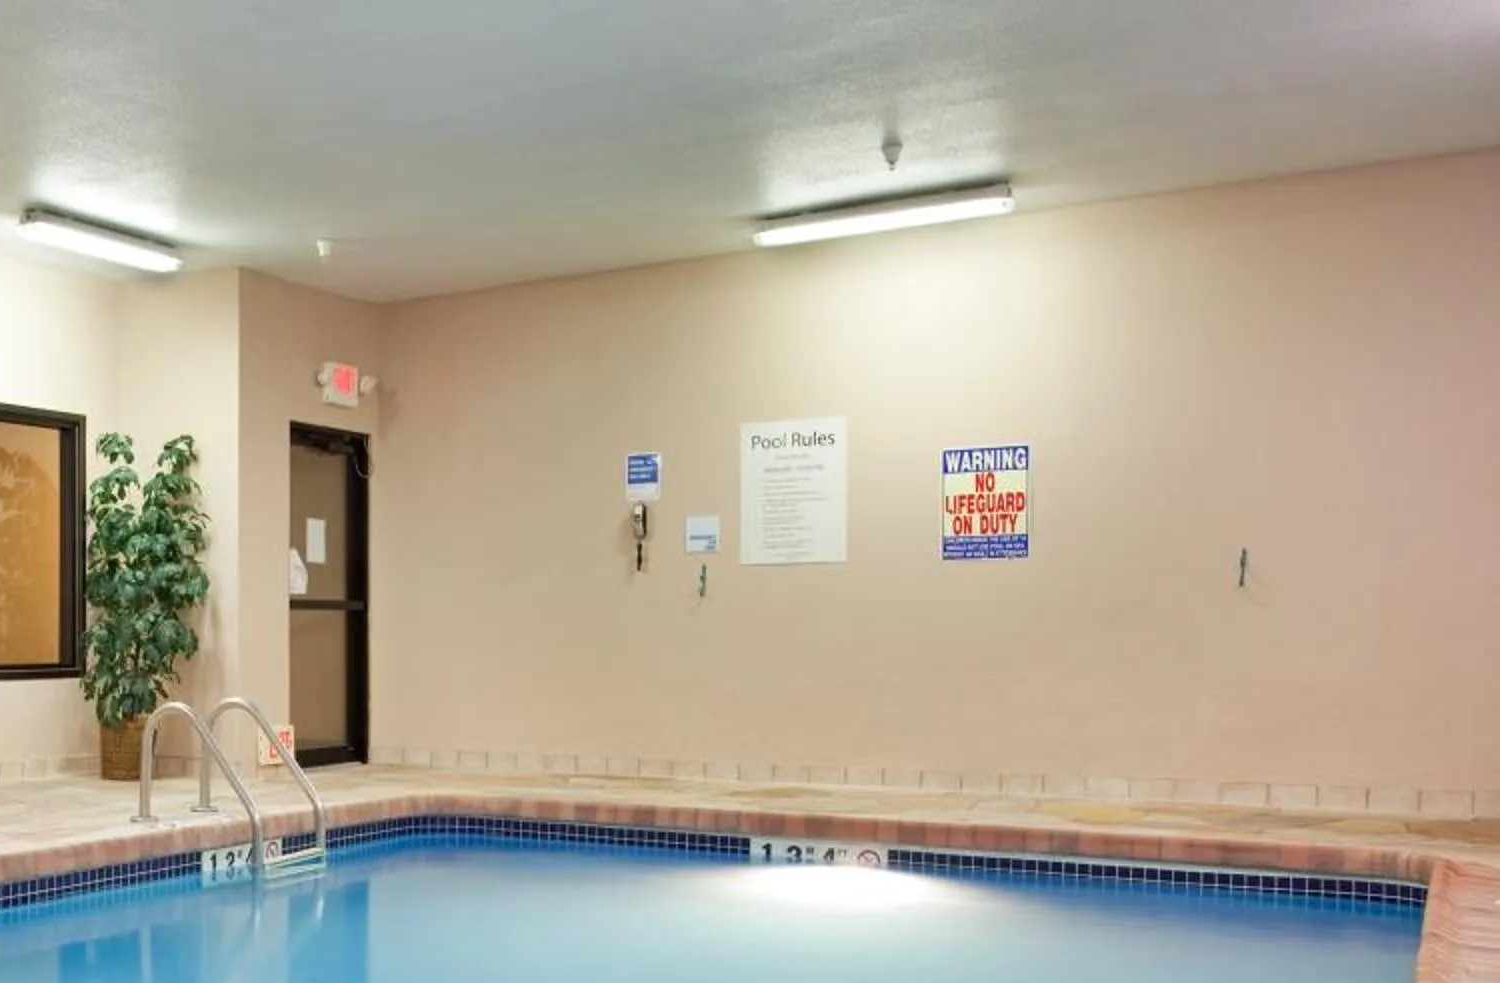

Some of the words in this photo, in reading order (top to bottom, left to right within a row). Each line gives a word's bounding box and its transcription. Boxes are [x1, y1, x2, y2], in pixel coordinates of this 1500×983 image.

[751, 432, 787, 449] Pool
[791, 431, 836, 447] Rules
[945, 448, 1027, 472] WARNING
[975, 472, 995, 493] NO
[945, 491, 1026, 514] LIFEGUARD
[953, 515, 973, 535] ON
[980, 513, 1018, 535] DUTY
